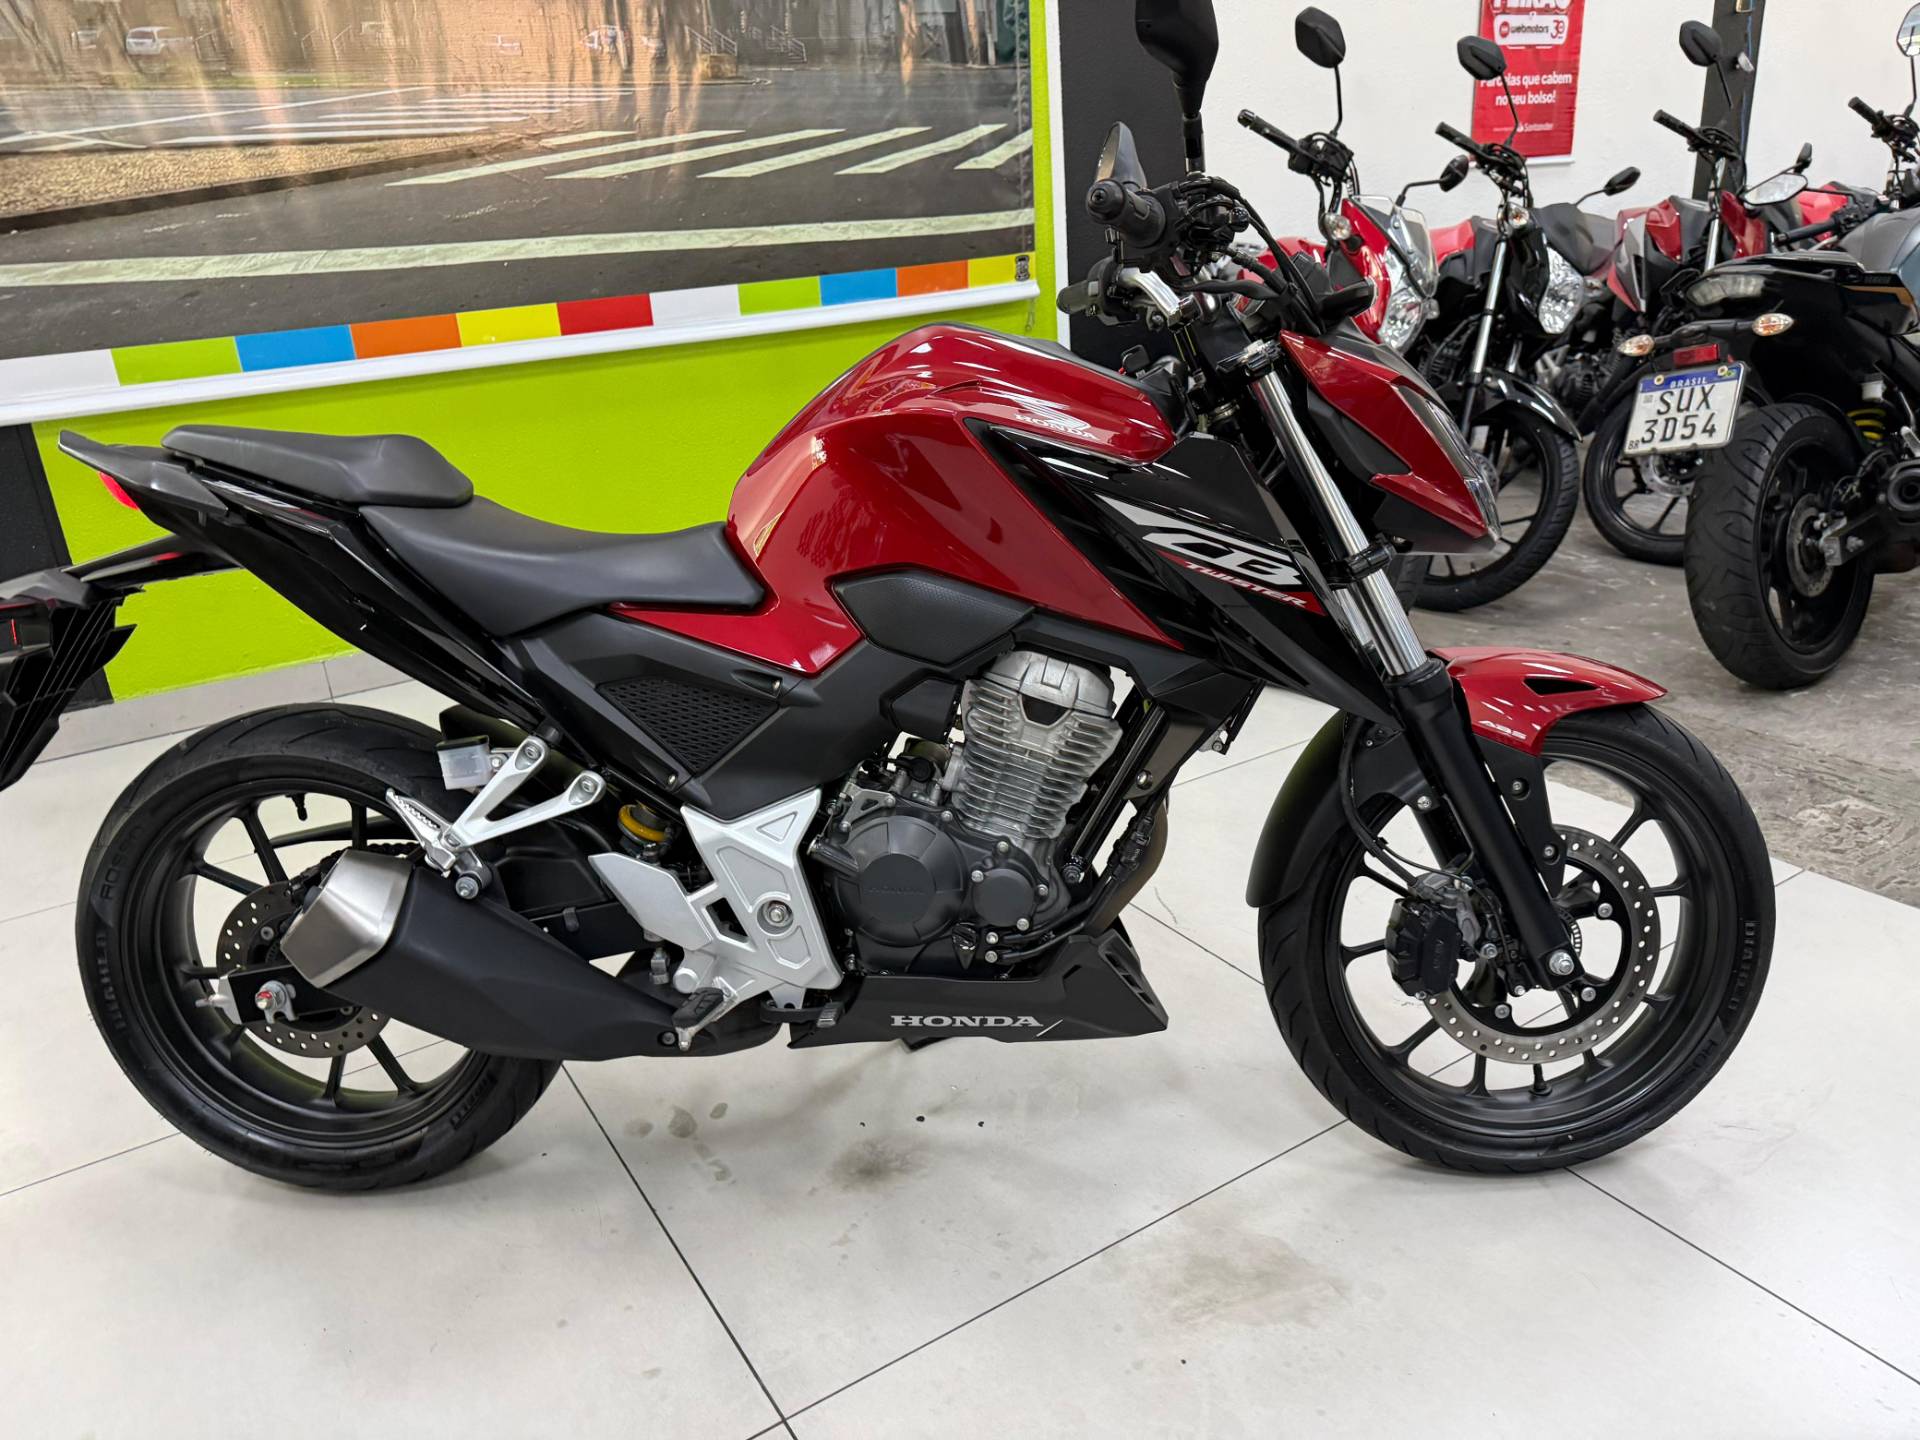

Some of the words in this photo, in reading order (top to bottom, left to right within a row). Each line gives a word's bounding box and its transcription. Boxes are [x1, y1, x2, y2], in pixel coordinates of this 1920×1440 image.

[1510, 24, 1549, 34] webmotors
[1522, 74, 1540, 89] que
[1541, 71, 1573, 84] cabem
[1495, 94, 1508, 106] no
[1527, 89, 1557, 104] bolso!
[1670, 376, 1707, 389] BRASIL
[1656, 384, 1716, 416] SUX
[1013, 413, 1100, 441] HONDA
[1641, 412, 1717, 444] 3D54
[1628, 439, 1640, 450] BR
[1182, 560, 1309, 609] TWISTER
[1478, 720, 1527, 740] ABS
[890, 1015, 1044, 1027] HONDA
